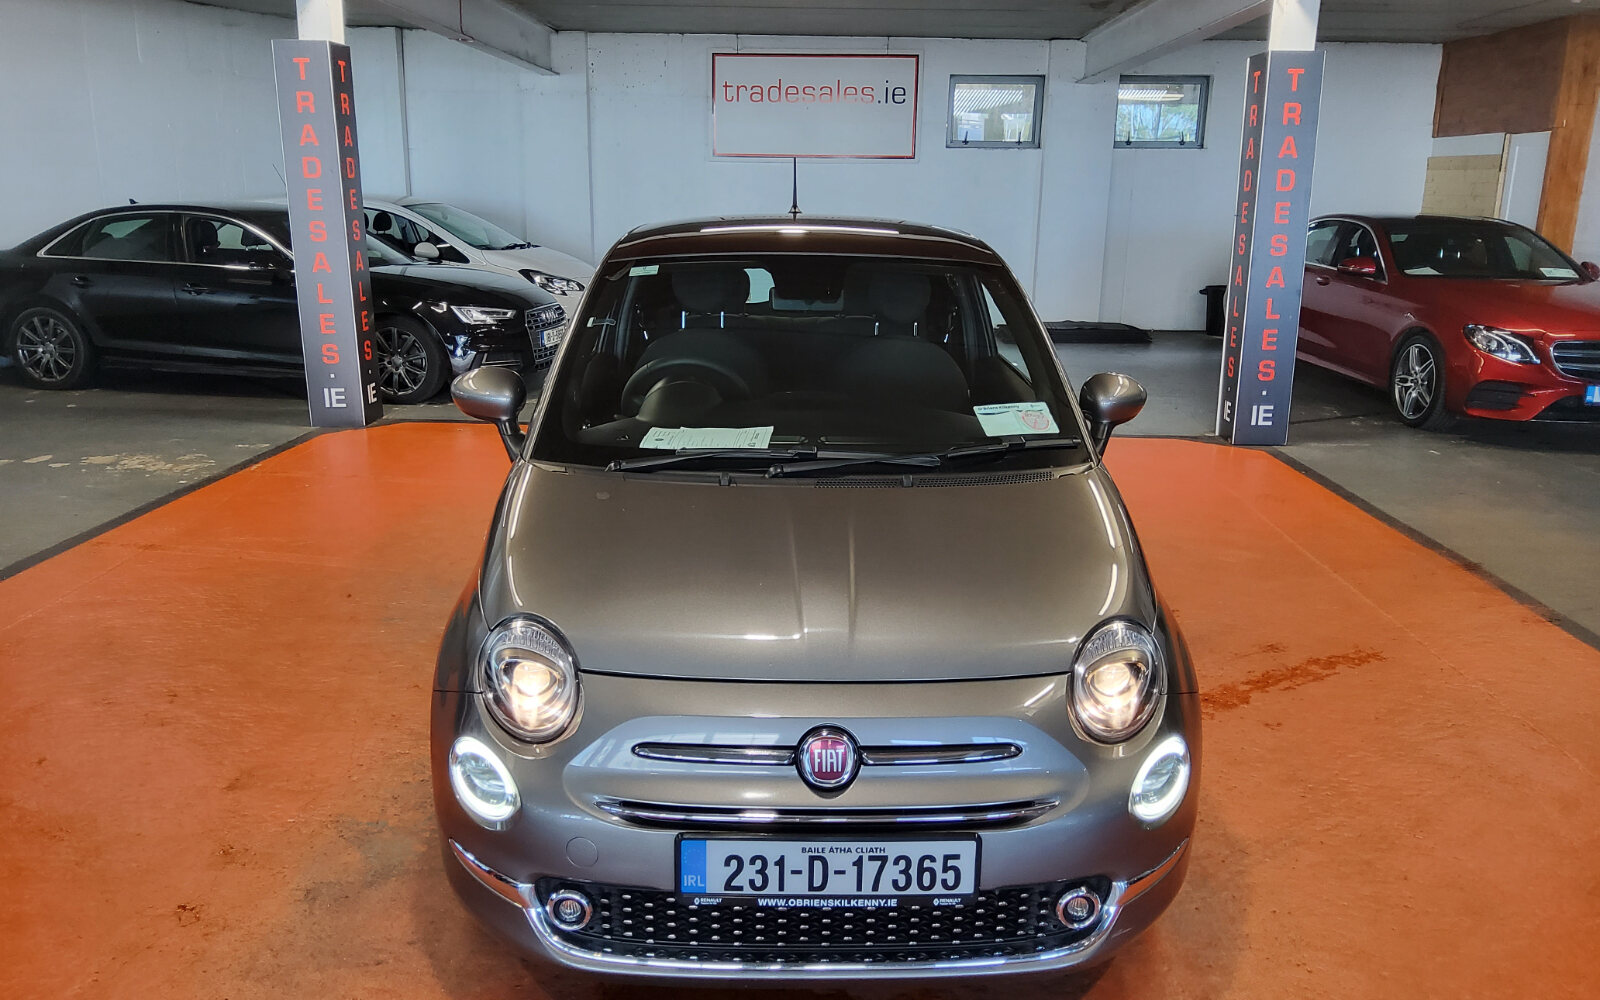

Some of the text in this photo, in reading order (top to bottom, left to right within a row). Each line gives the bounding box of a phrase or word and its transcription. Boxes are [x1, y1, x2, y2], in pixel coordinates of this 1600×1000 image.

[722, 78, 906, 104] tradesales.ie
[814, 748, 845, 773] FIAT
[801, 844, 886, 854] BAILE ÁTHA CLIATH
[684, 875, 705, 887] IRL
[724, 854, 962, 892] 231-D-17365
[757, 898, 898, 907] WWW.OBRIENSKILKENNY.IE
